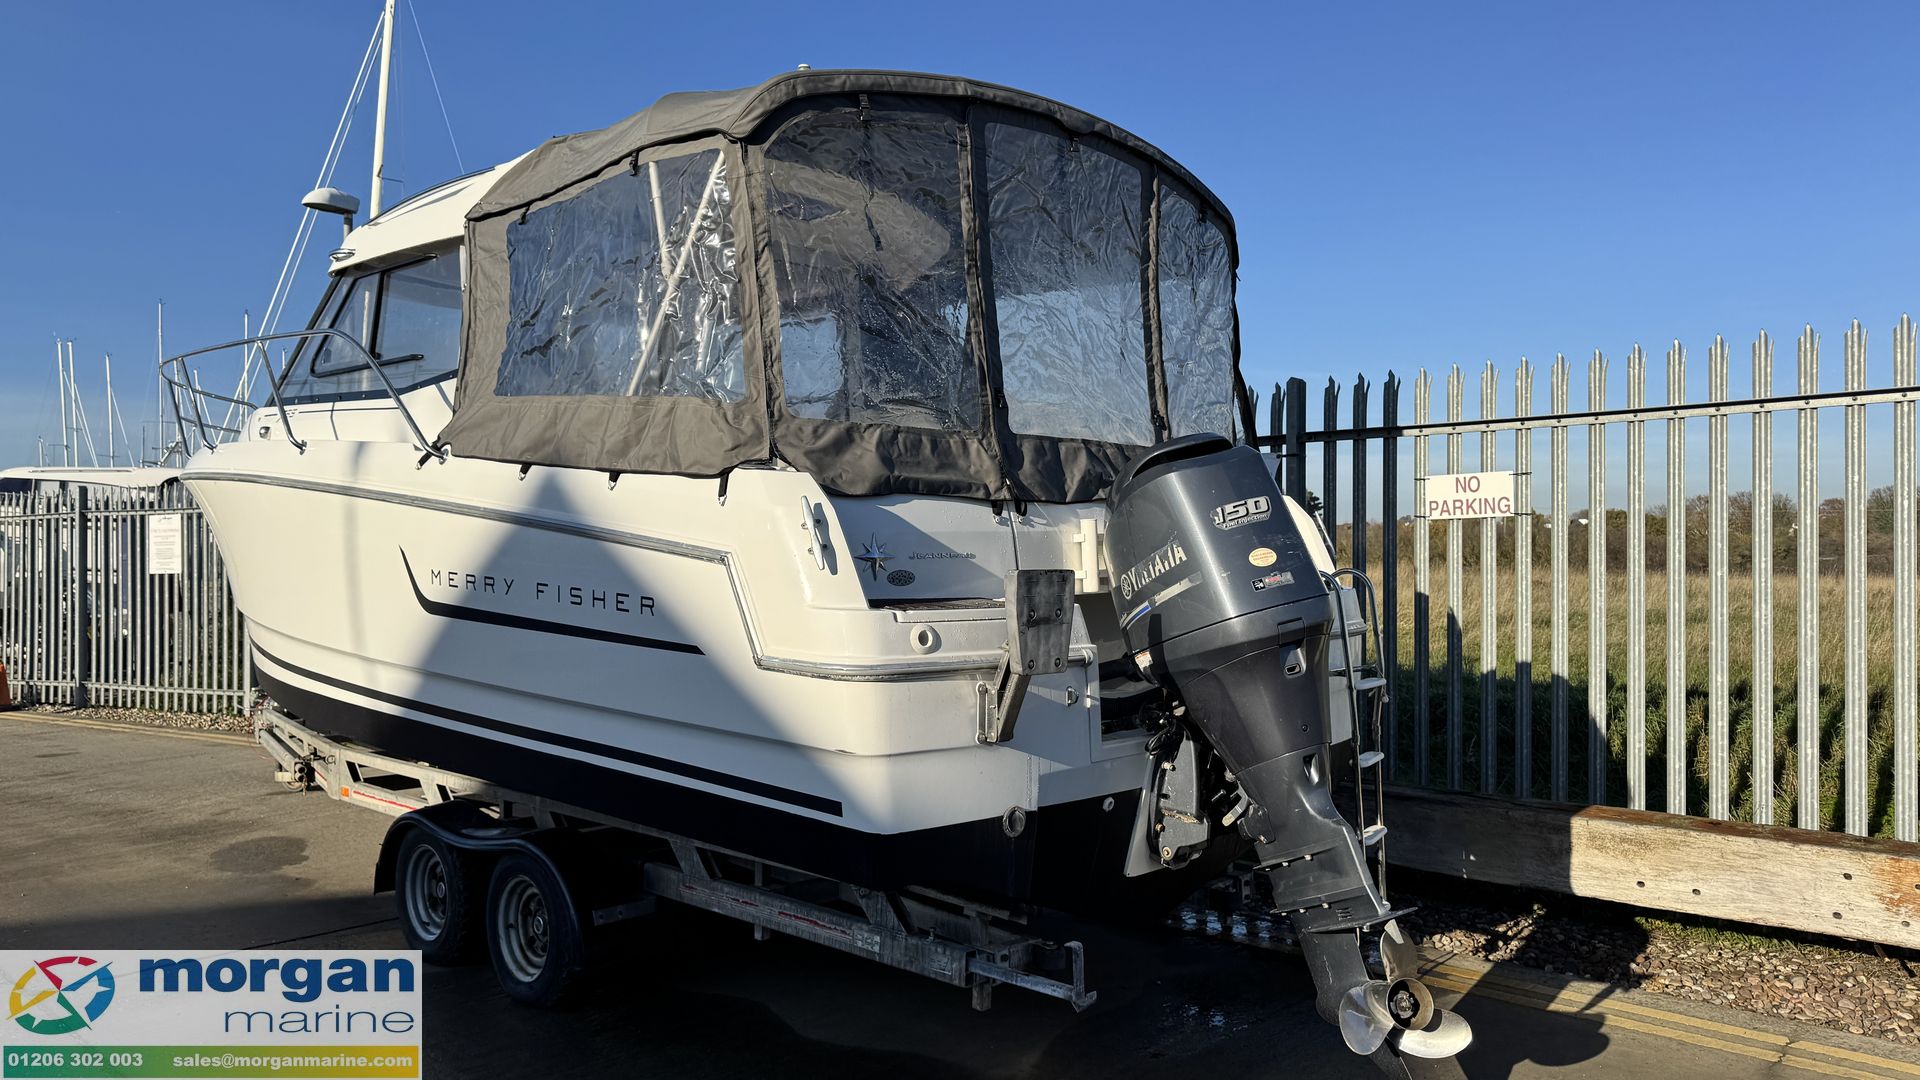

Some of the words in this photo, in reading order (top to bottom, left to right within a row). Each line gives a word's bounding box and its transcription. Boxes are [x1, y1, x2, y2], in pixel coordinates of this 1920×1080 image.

[1455, 476, 1480, 493] NO
[1213, 496, 1270, 525] 150
[1429, 497, 1511, 516] PARKING
[431, 569, 514, 595] MERRY
[536, 582, 655, 616] FISHER
